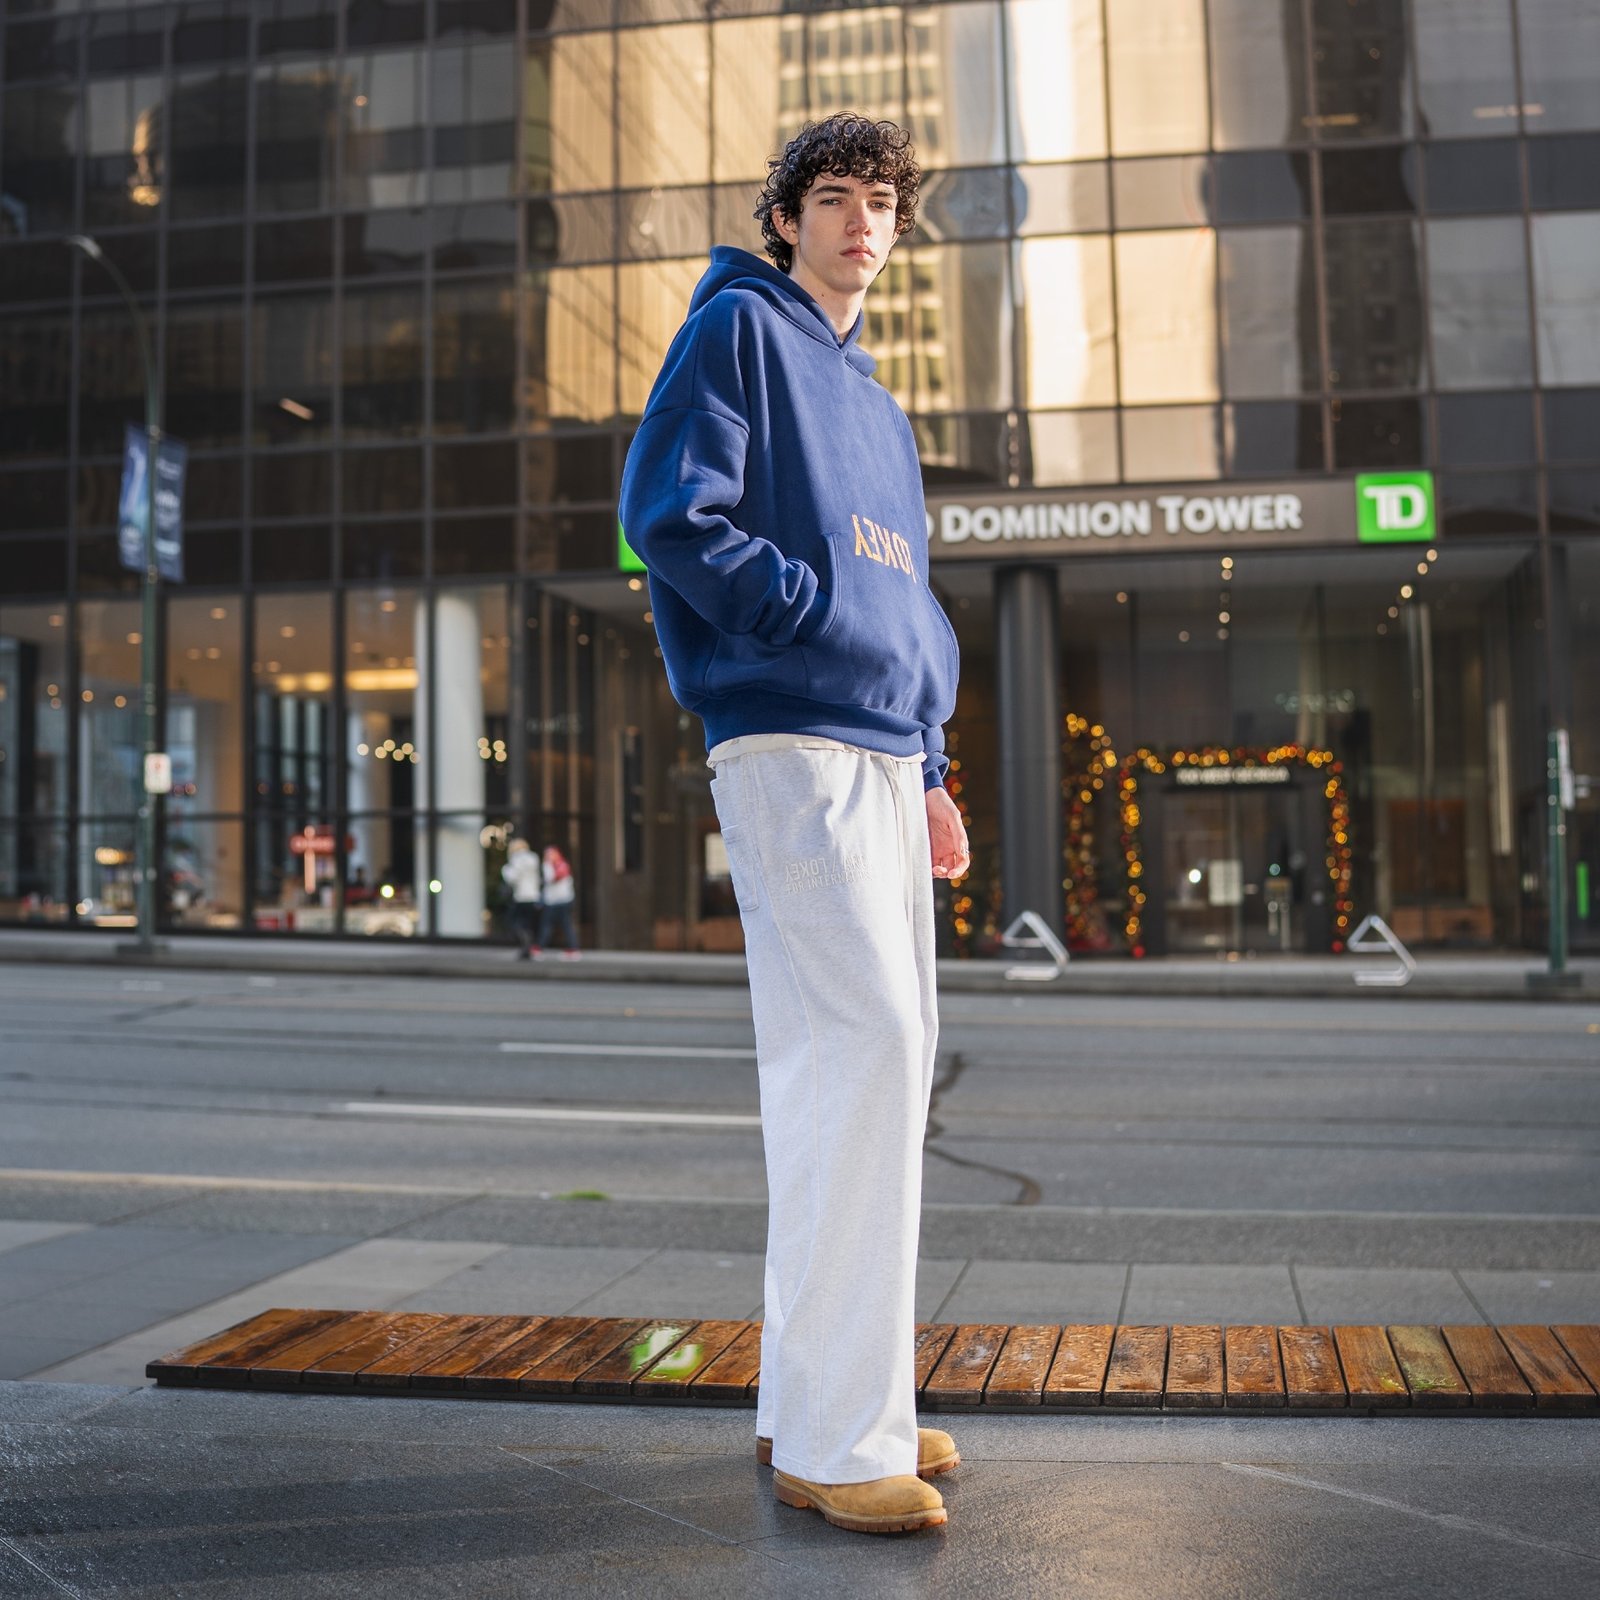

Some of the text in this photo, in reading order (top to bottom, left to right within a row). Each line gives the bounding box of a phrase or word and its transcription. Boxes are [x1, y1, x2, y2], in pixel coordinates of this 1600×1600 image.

[941, 501, 1150, 542] DOMINION
[1157, 494, 1303, 533] TOWER
[1363, 484, 1427, 530] TD
